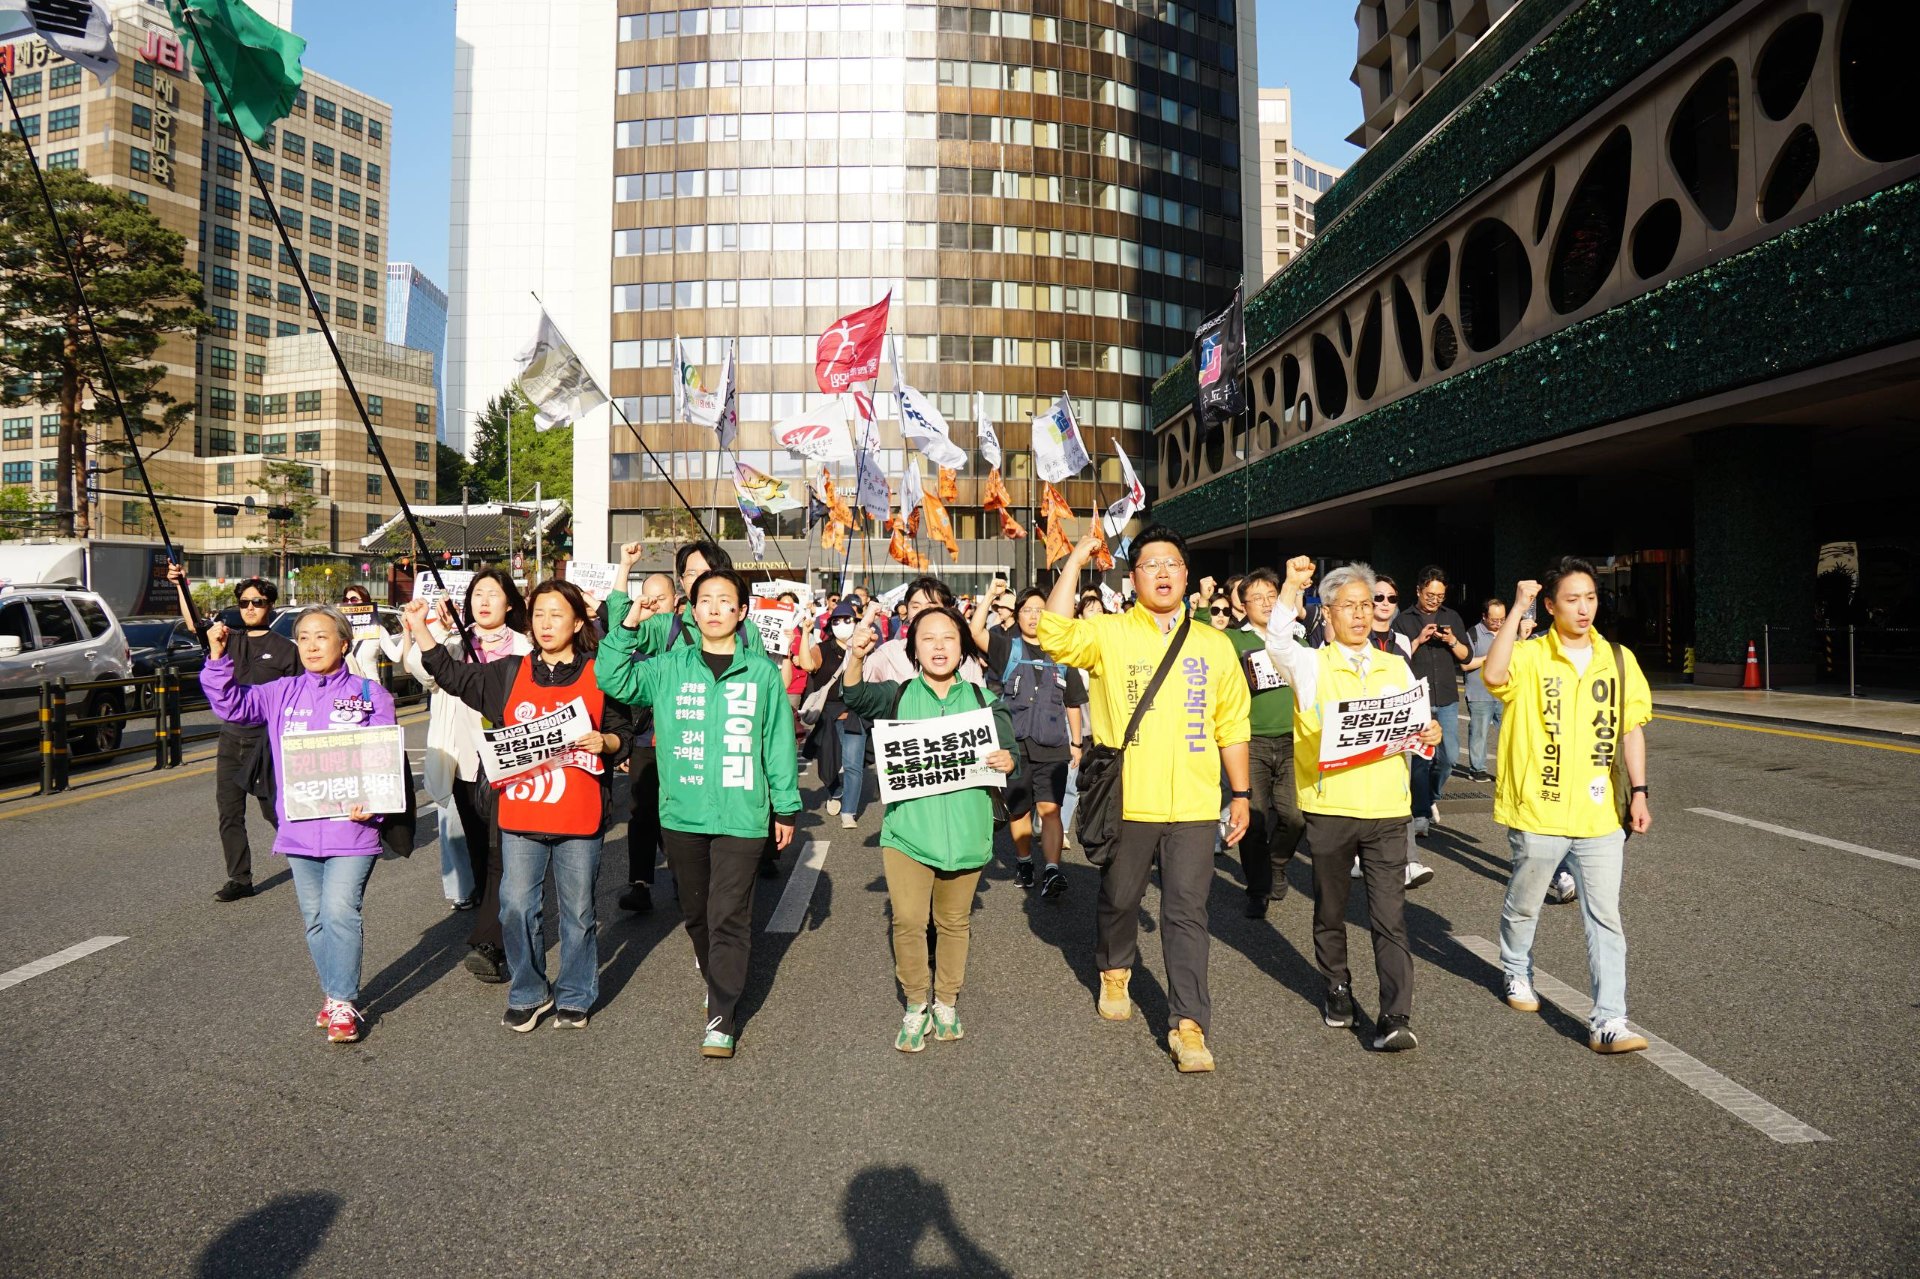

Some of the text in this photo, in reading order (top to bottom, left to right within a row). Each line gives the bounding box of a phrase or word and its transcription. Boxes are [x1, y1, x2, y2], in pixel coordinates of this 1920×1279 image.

[138, 30, 184, 72] JEI
[152, 75, 174, 184] 재능교육
[1341, 707, 1411, 730] 원청교섭
[1541, 677, 1563, 787] 강서구의원
[1591, 677, 1617, 772] 이상욱
[494, 729, 563, 756] 원청교섭
[681, 730, 705, 745] 강서
[723, 682, 757, 790] 김유리
[884, 725, 993, 758] 모든 노동자의
[673, 746, 704, 760] 구의원
[886, 750, 977, 776] 노동기본권
[293, 776, 359, 803] 근로기준법
[680, 775, 704, 785] 녹색당
[888, 767, 966, 791] 쟁취하자!
[1540, 789, 1561, 803] 후보
